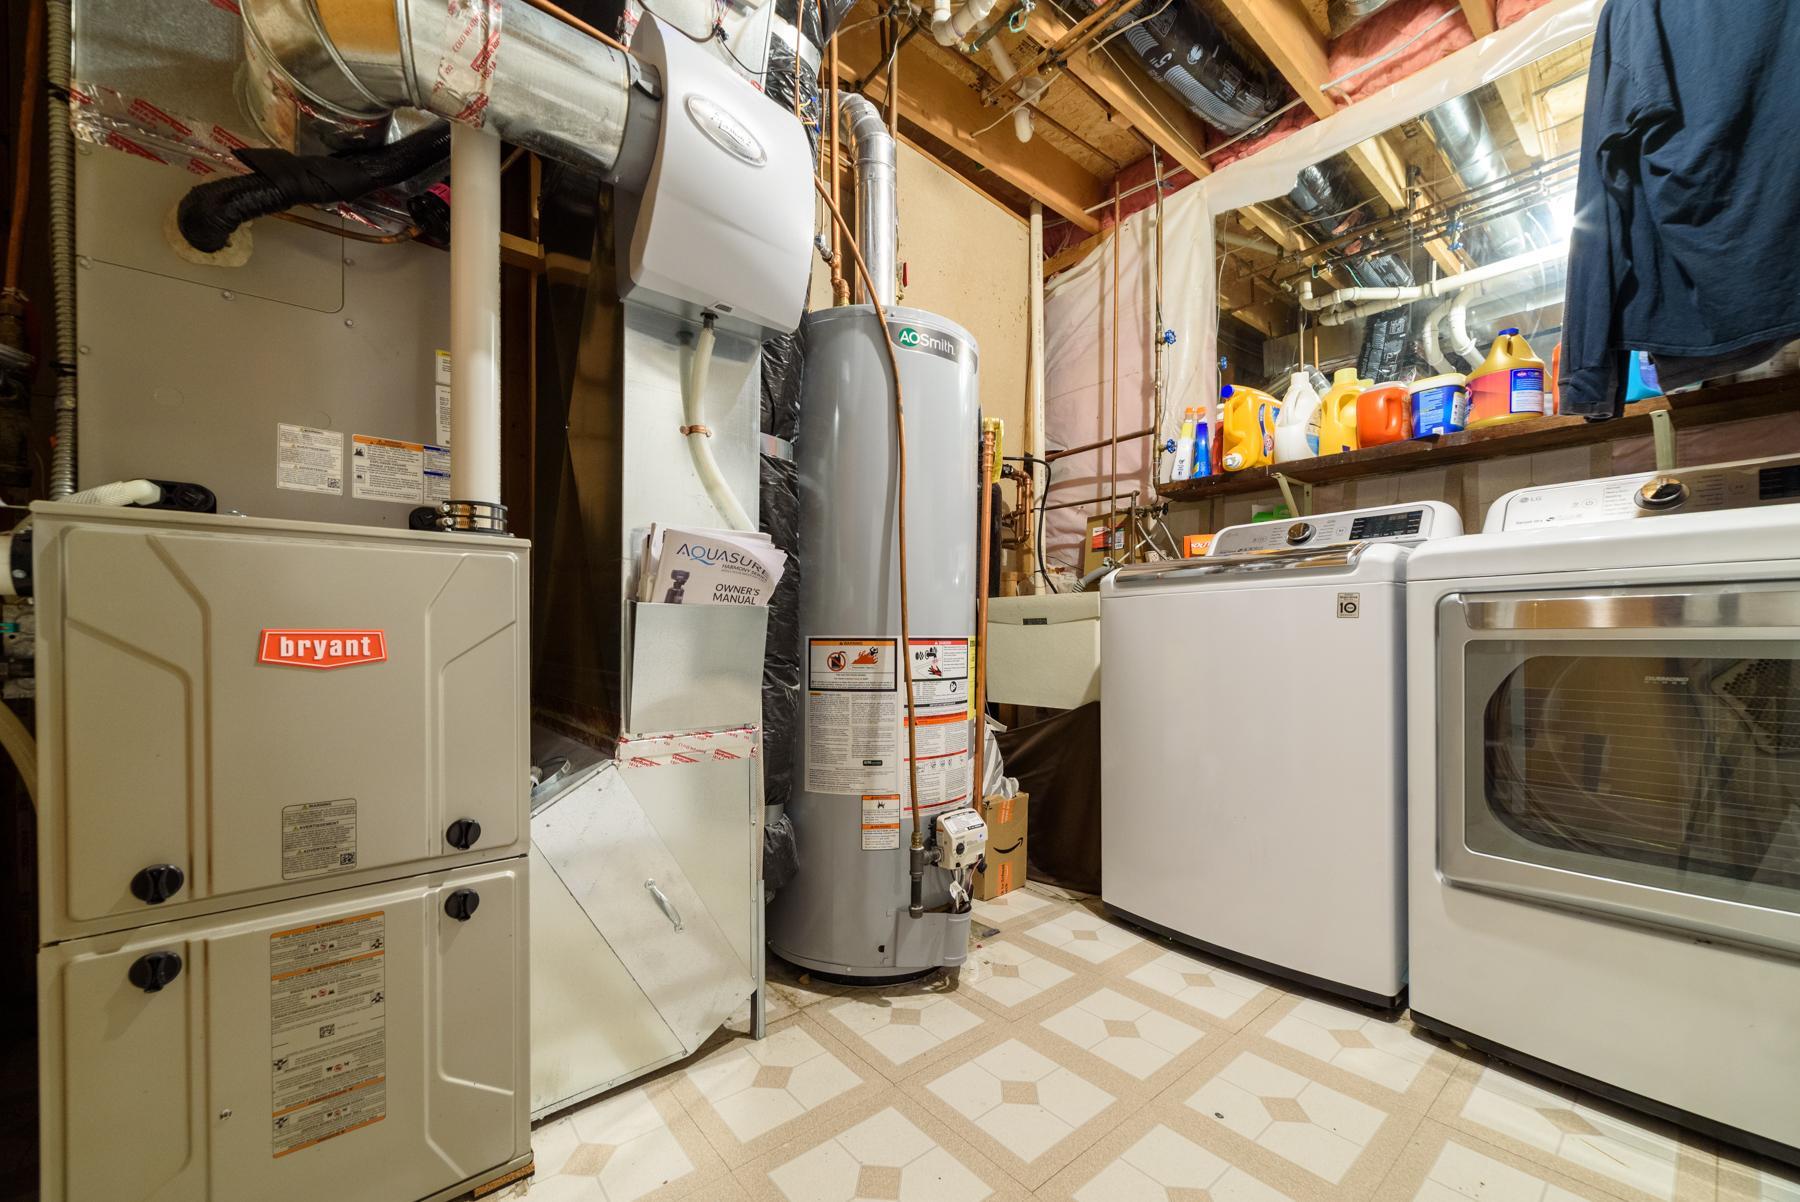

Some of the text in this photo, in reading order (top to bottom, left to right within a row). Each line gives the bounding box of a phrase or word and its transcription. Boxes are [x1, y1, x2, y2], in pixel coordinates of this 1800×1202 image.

[715, 583, 760, 596] OWNER'S
[712, 592, 757, 606] MANUAL
[279, 636, 371, 660] bryant
